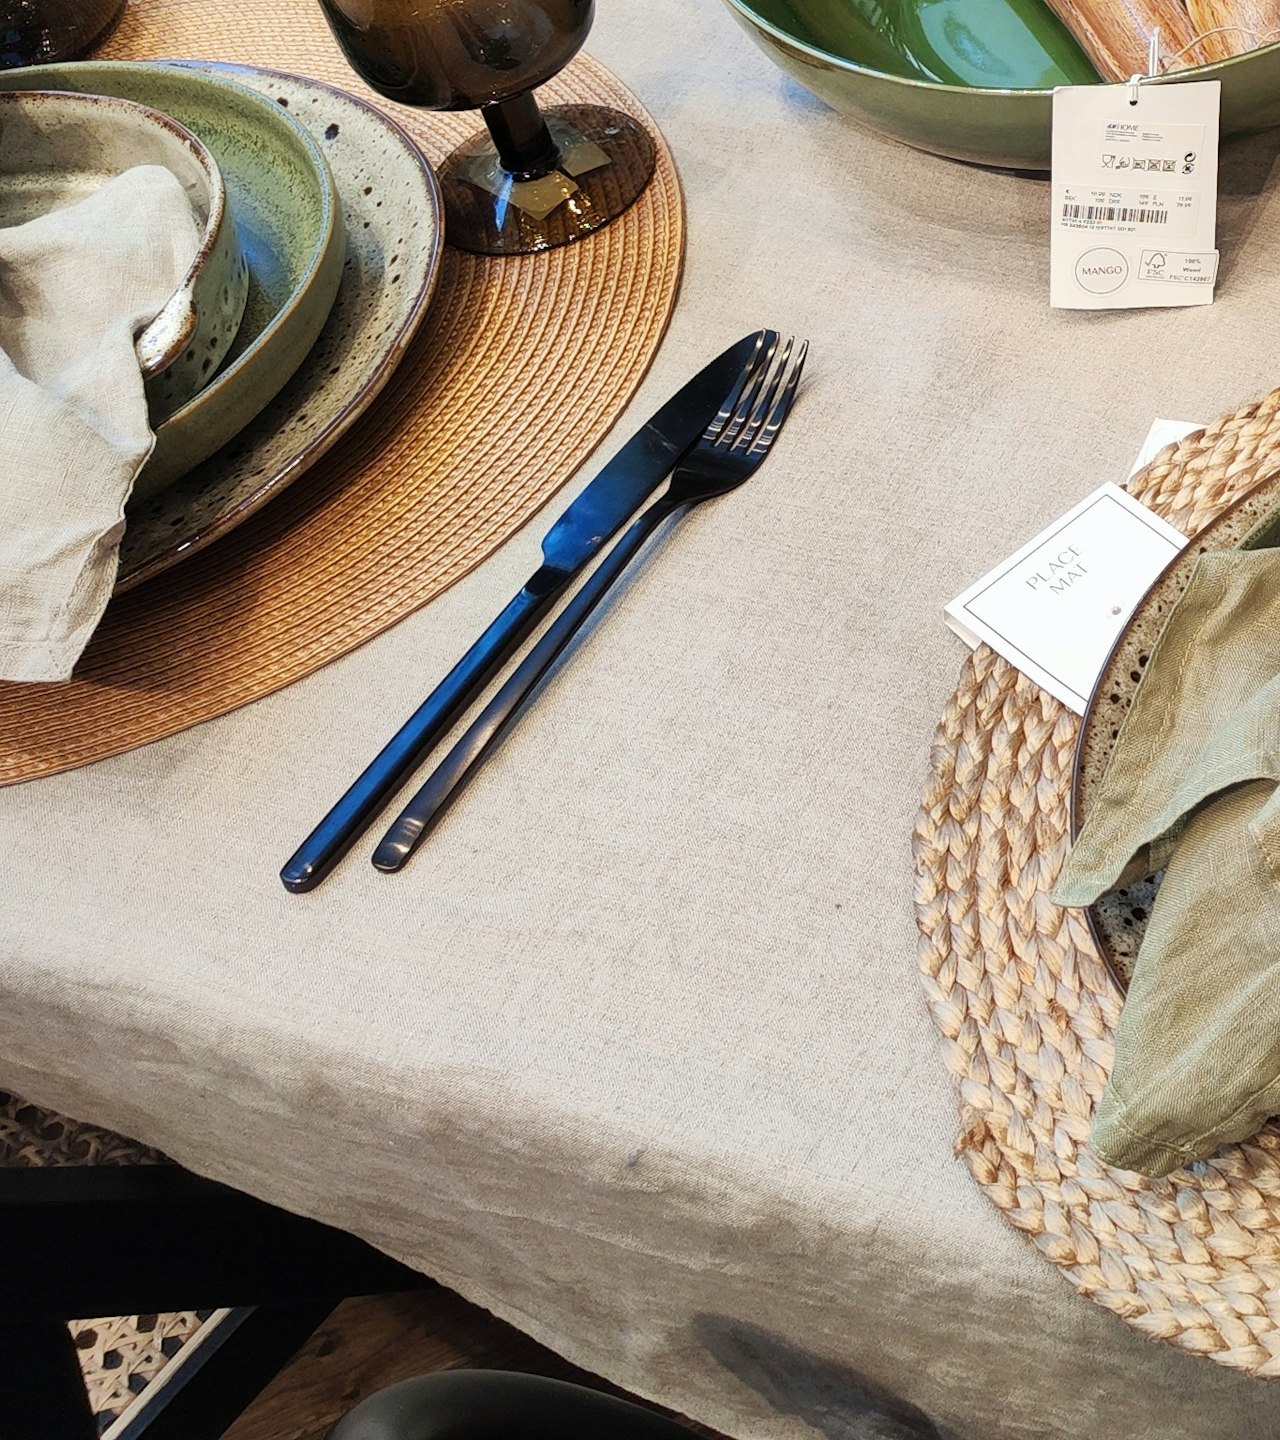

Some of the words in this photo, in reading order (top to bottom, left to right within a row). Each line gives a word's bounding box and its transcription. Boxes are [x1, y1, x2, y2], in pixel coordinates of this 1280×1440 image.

[1082, 265, 1122, 276] MANGO
[1025, 543, 1084, 590] PLACE
[1049, 561, 1088, 596] MAT
